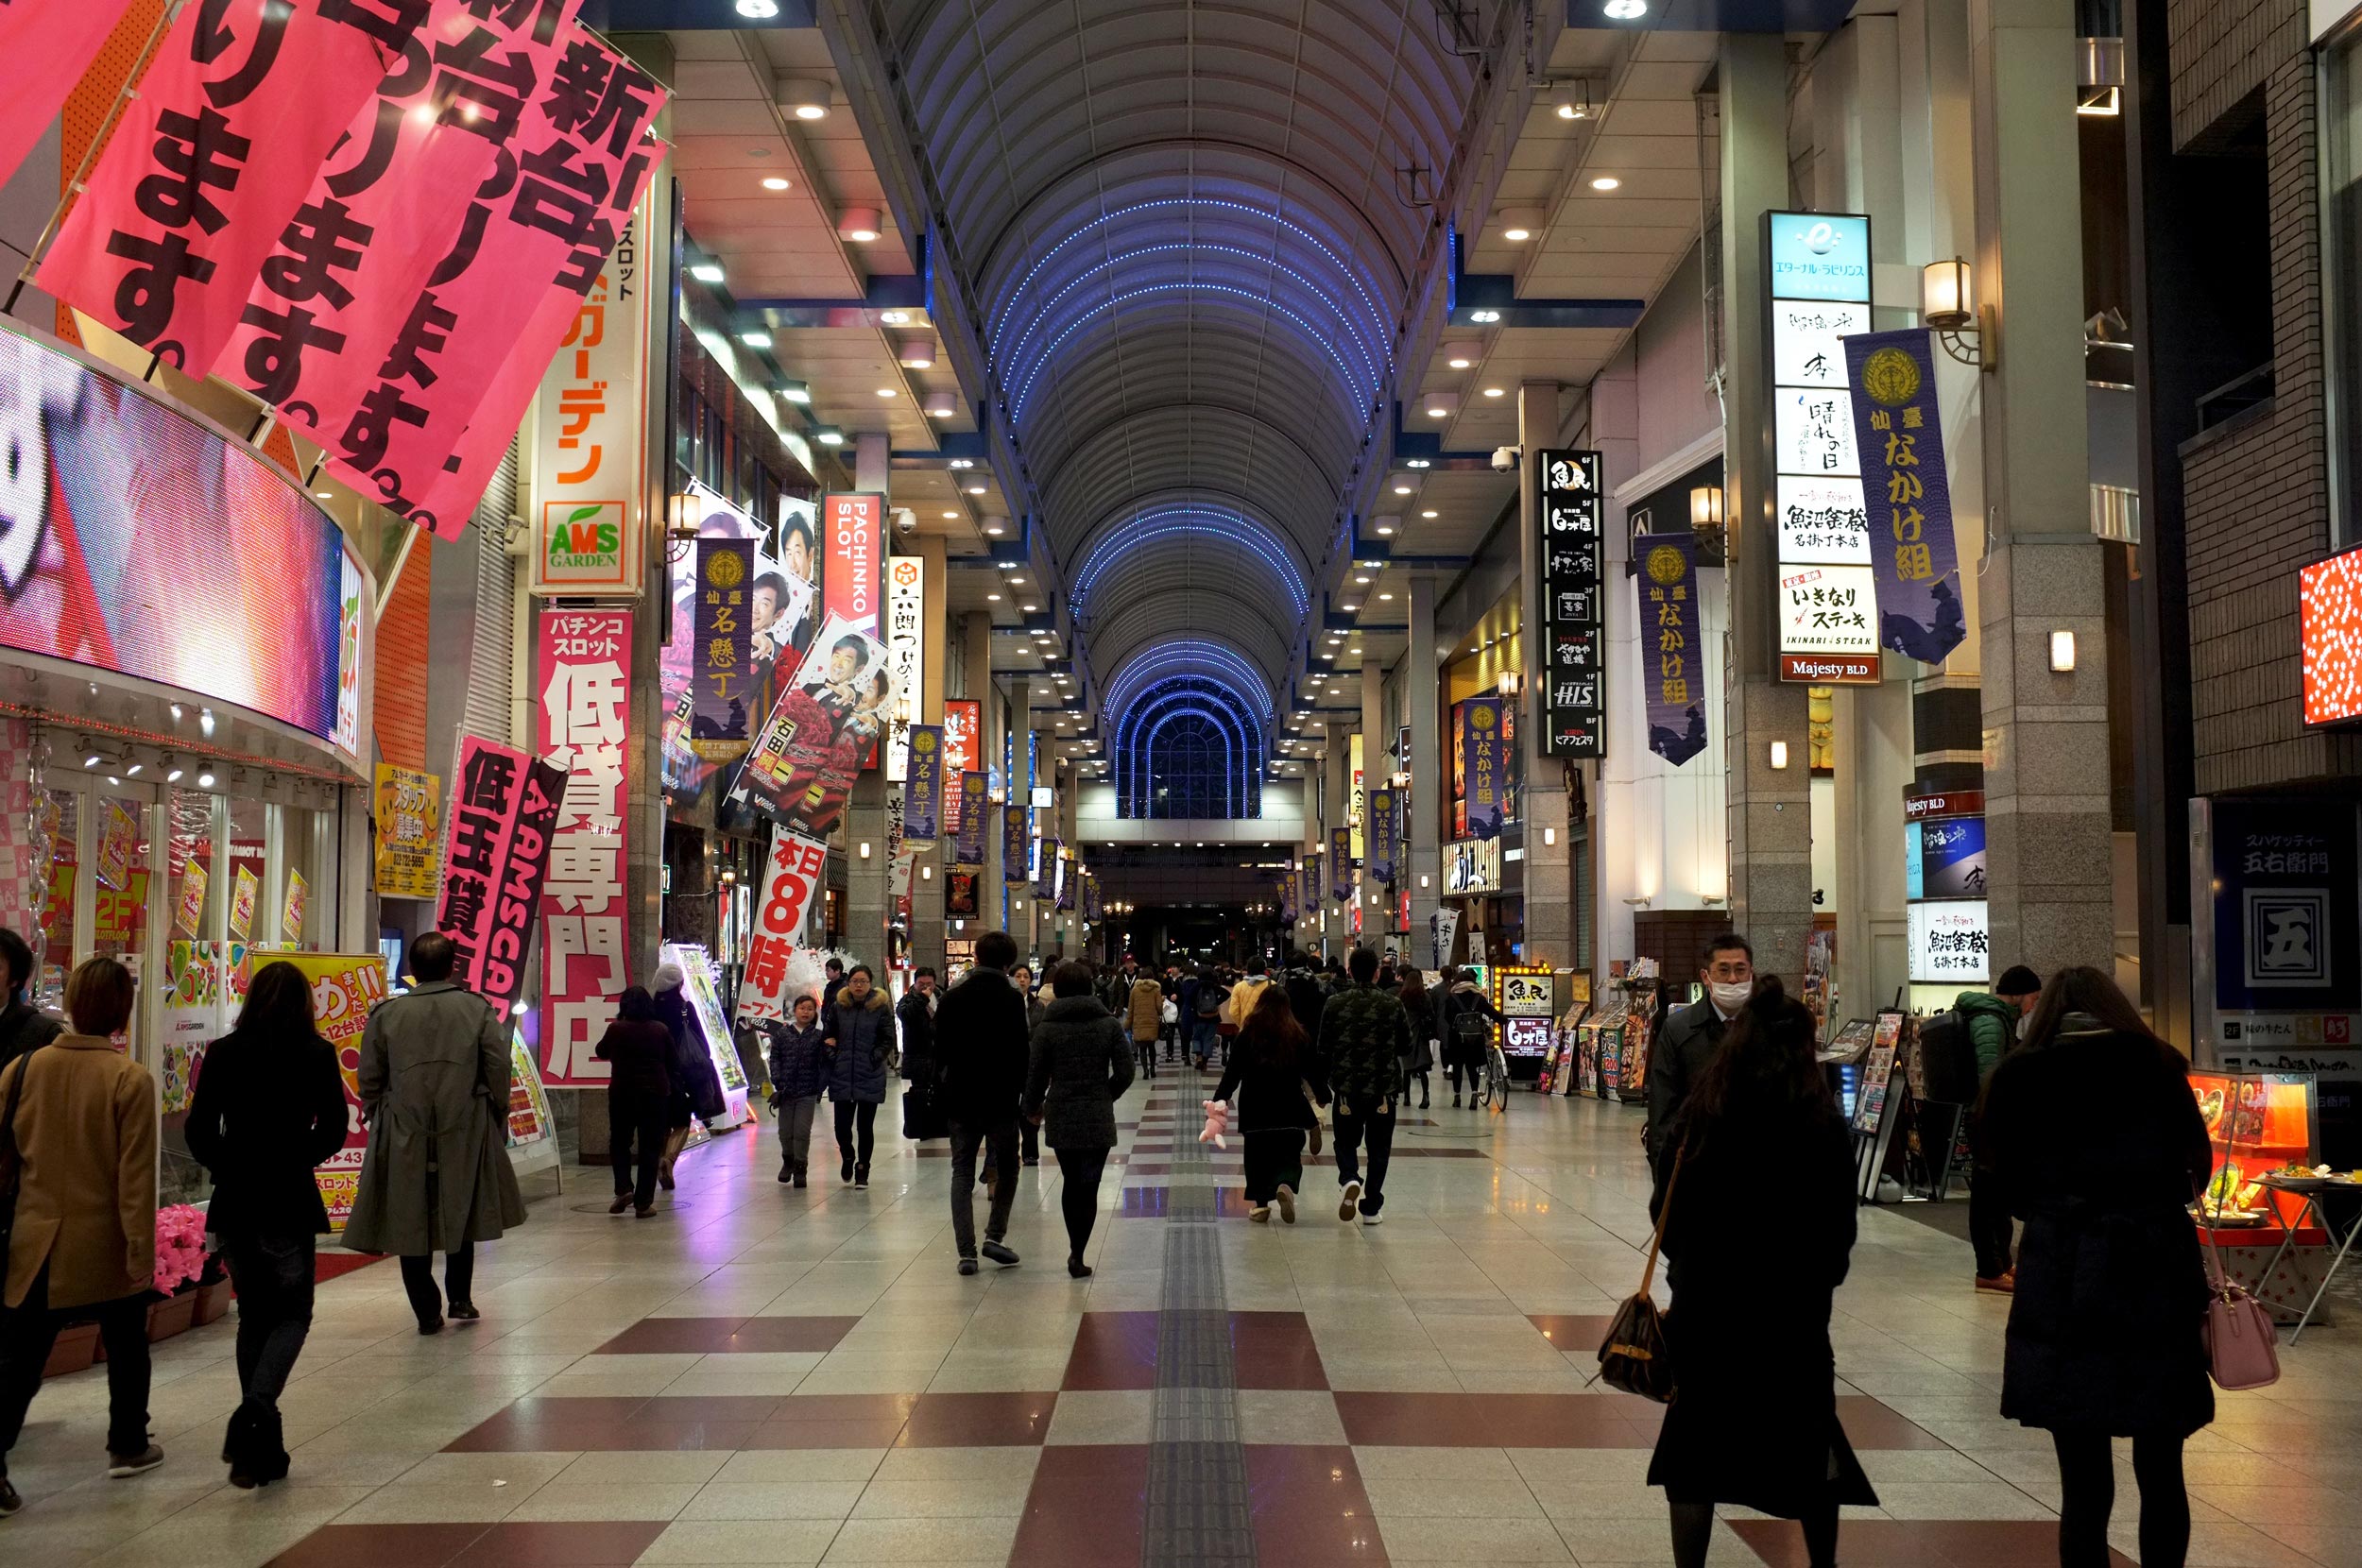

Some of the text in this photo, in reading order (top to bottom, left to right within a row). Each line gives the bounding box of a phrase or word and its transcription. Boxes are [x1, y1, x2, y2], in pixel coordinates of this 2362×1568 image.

[1775, 262, 1865, 277] エターナル・ラビリンス
[557, 272, 608, 485] ガーデン
[1809, 401, 1840, 470] 晴れの日
[1551, 508, 1592, 531] 白木屋
[1784, 504, 1869, 532] 魚沼釜蔵
[1885, 432, 1934, 582] なかけ組
[549, 522, 619, 554] AMS
[837, 503, 852, 560] SLOT
[1794, 534, 1858, 549] 名掛丁本店
[550, 554, 618, 568] GARDEN
[852, 503, 867, 614] PACHINKO
[1792, 587, 1857, 607] いきなり
[550, 617, 624, 637] パチンコ
[1812, 611, 1866, 629] ステーキ
[553, 638, 620, 656] スロット
[1836, 637, 1872, 645] STEAK
[1658, 603, 1688, 705] なかけ組
[1792, 661, 1869, 679] Majesty BLD
[1477, 741, 1494, 805] なかけ組
[1929, 797, 1945, 810] BLD
[774, 837, 825, 879] 本日
[2243, 850, 2330, 875] 五右衛門
[95, 890, 132, 929] 2F
[1927, 929, 1988, 954] 魚沼釜蔵
[1933, 955, 1980, 969] 名掛丁本店
[342, 971, 366, 1014] ました
[1508, 979, 1548, 1001] 魚民
[1507, 1019, 1549, 1046] 白木屋
[2245, 1024, 2292, 1034] 味の牛たん
